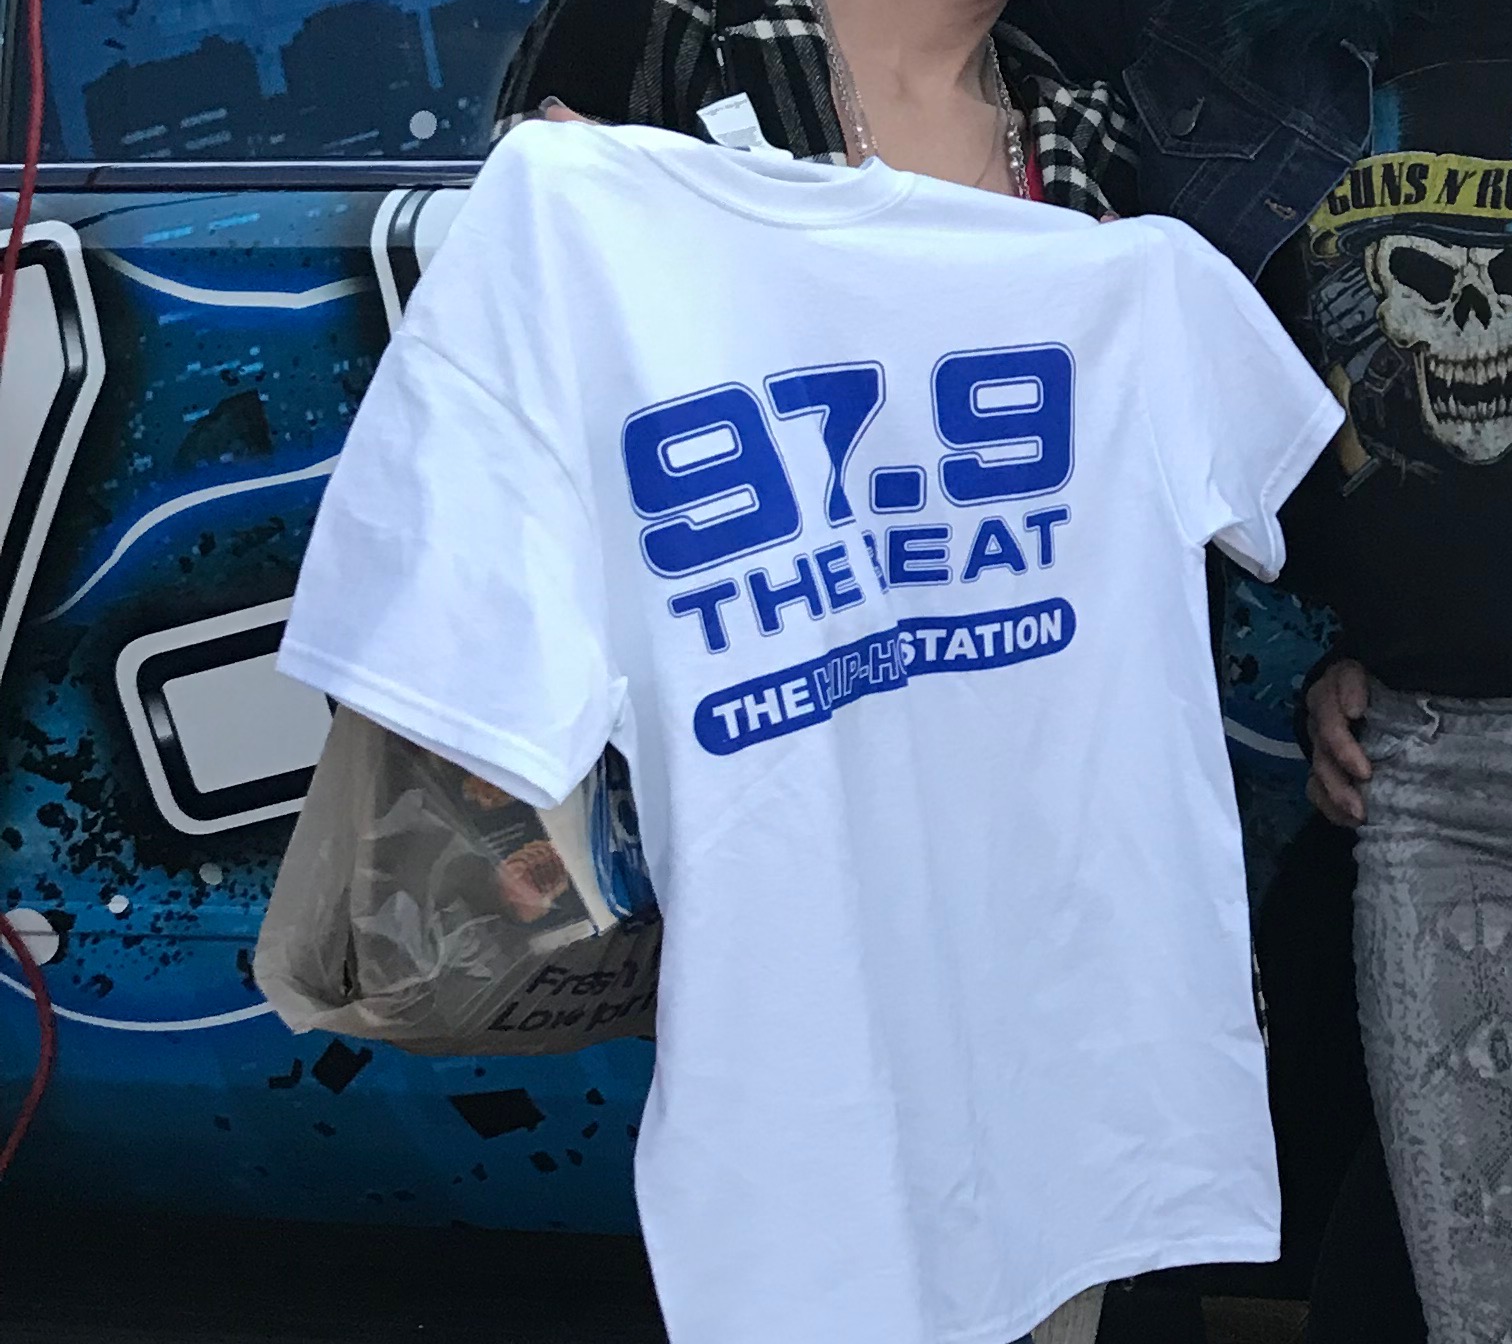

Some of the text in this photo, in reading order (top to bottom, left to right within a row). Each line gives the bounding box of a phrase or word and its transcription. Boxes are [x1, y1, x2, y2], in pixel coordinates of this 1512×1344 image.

[621, 342, 1076, 579] 97.9
[668, 504, 1072, 654] THE EAT
[713, 677, 816, 744] THE
[897, 608, 1064, 668] STATION
